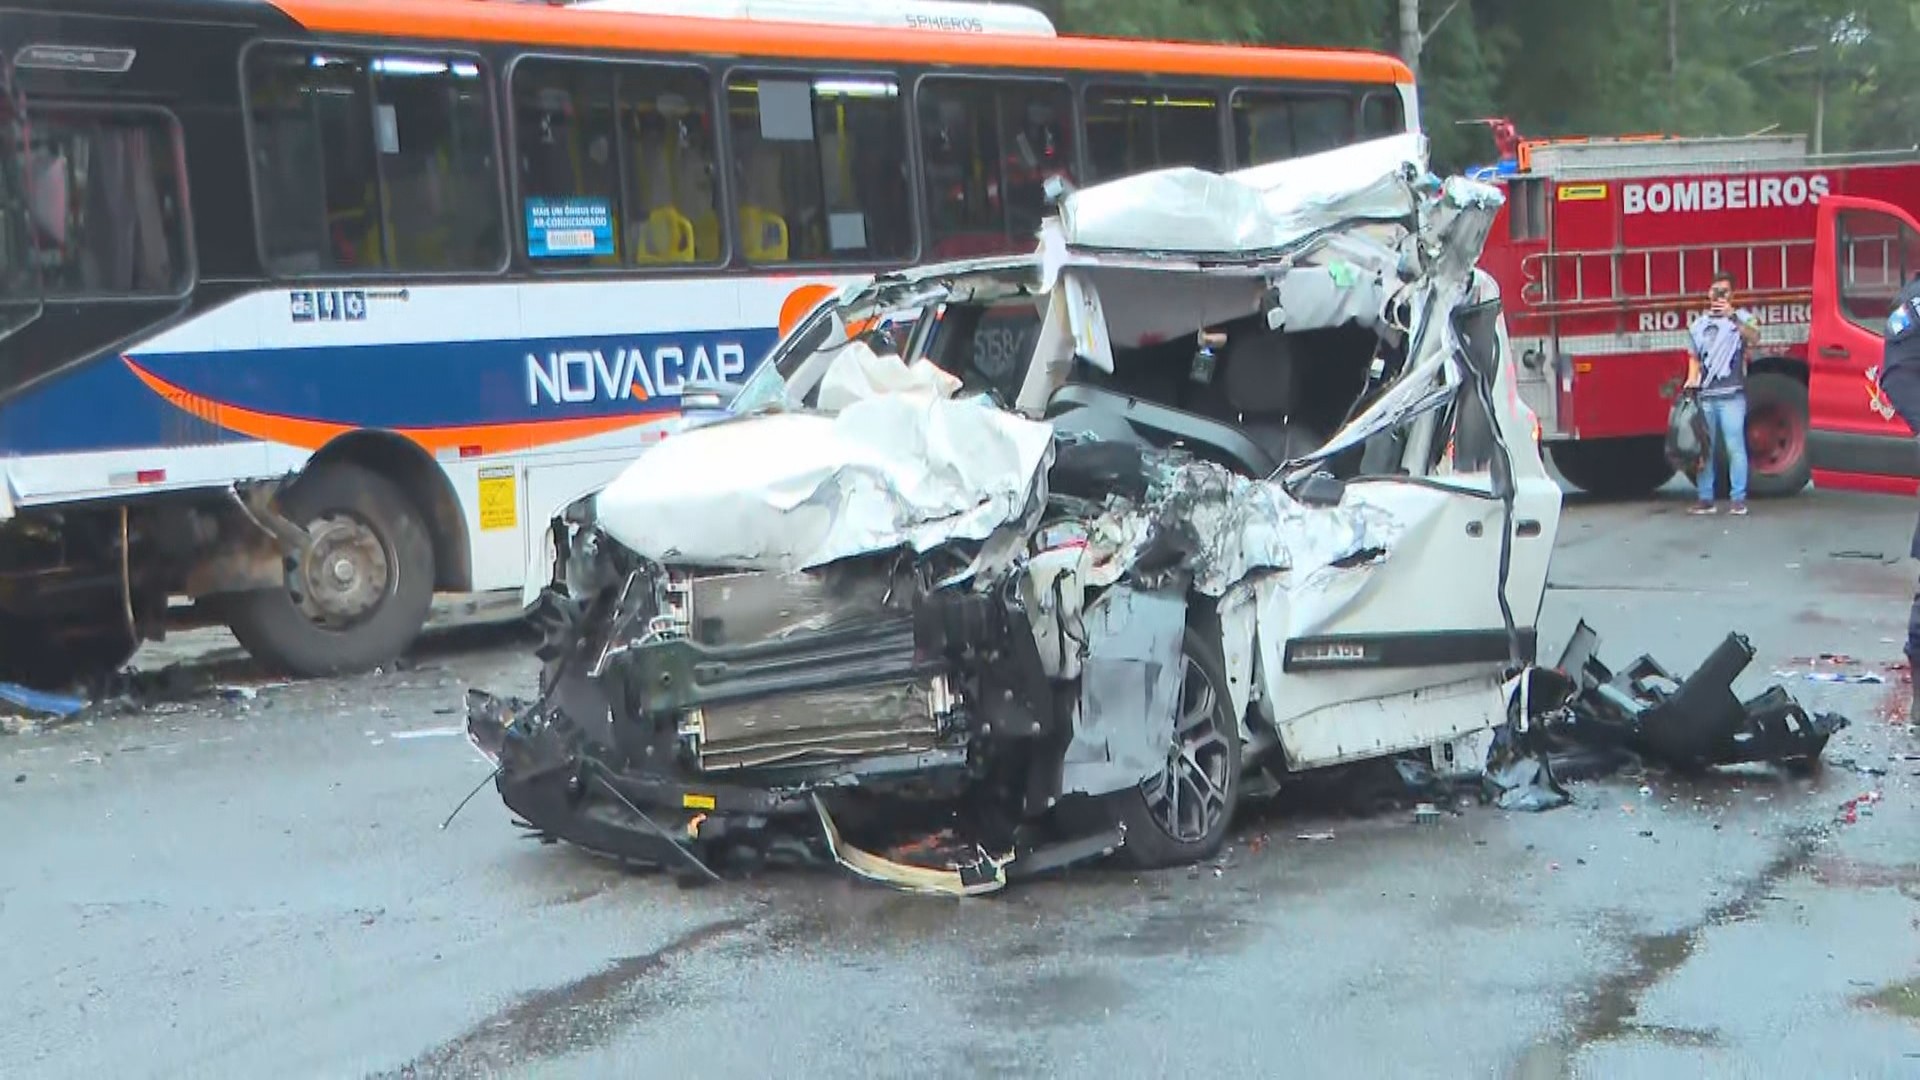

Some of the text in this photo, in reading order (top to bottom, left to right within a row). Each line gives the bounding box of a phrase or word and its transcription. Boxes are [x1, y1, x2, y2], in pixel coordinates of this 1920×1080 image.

[905, 14, 983, 32] SPHEROS
[1623, 175, 1829, 214] BOMBEIROS
[1639, 311, 1679, 331] RIO
[526, 344, 745, 405] NOVACAP
